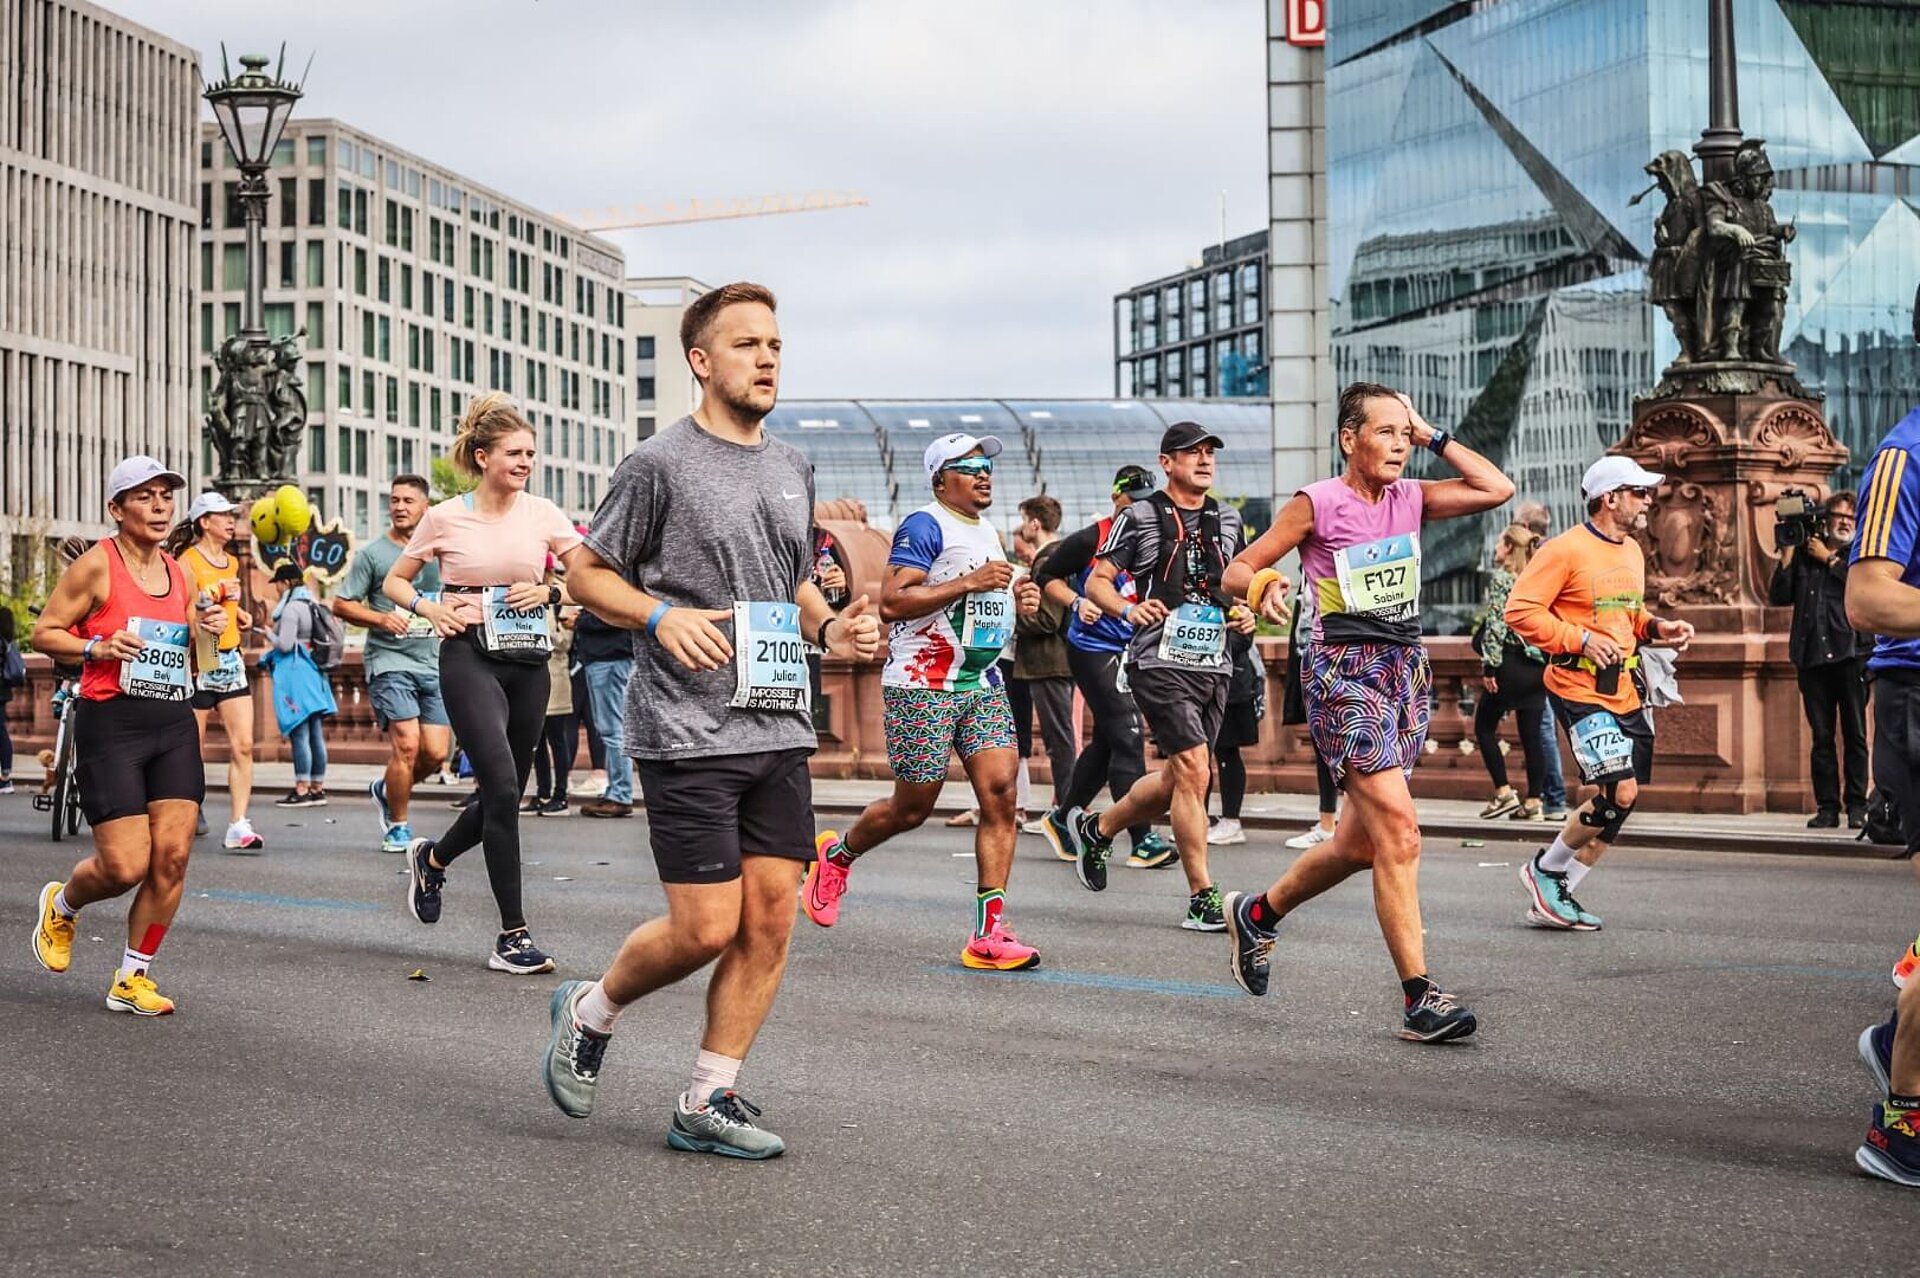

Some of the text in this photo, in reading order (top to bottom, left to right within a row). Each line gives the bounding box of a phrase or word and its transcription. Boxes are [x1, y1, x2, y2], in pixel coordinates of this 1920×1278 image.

[311, 538, 343, 565] GO
[1364, 566, 1406, 591] F127
[967, 600, 1004, 616] 31887
[1176, 625, 1220, 642] 66837
[772, 669, 797, 682] Julian
[751, 688, 796, 699] IMPOSSIBLE
[748, 698, 795, 710] IS NOTHING
